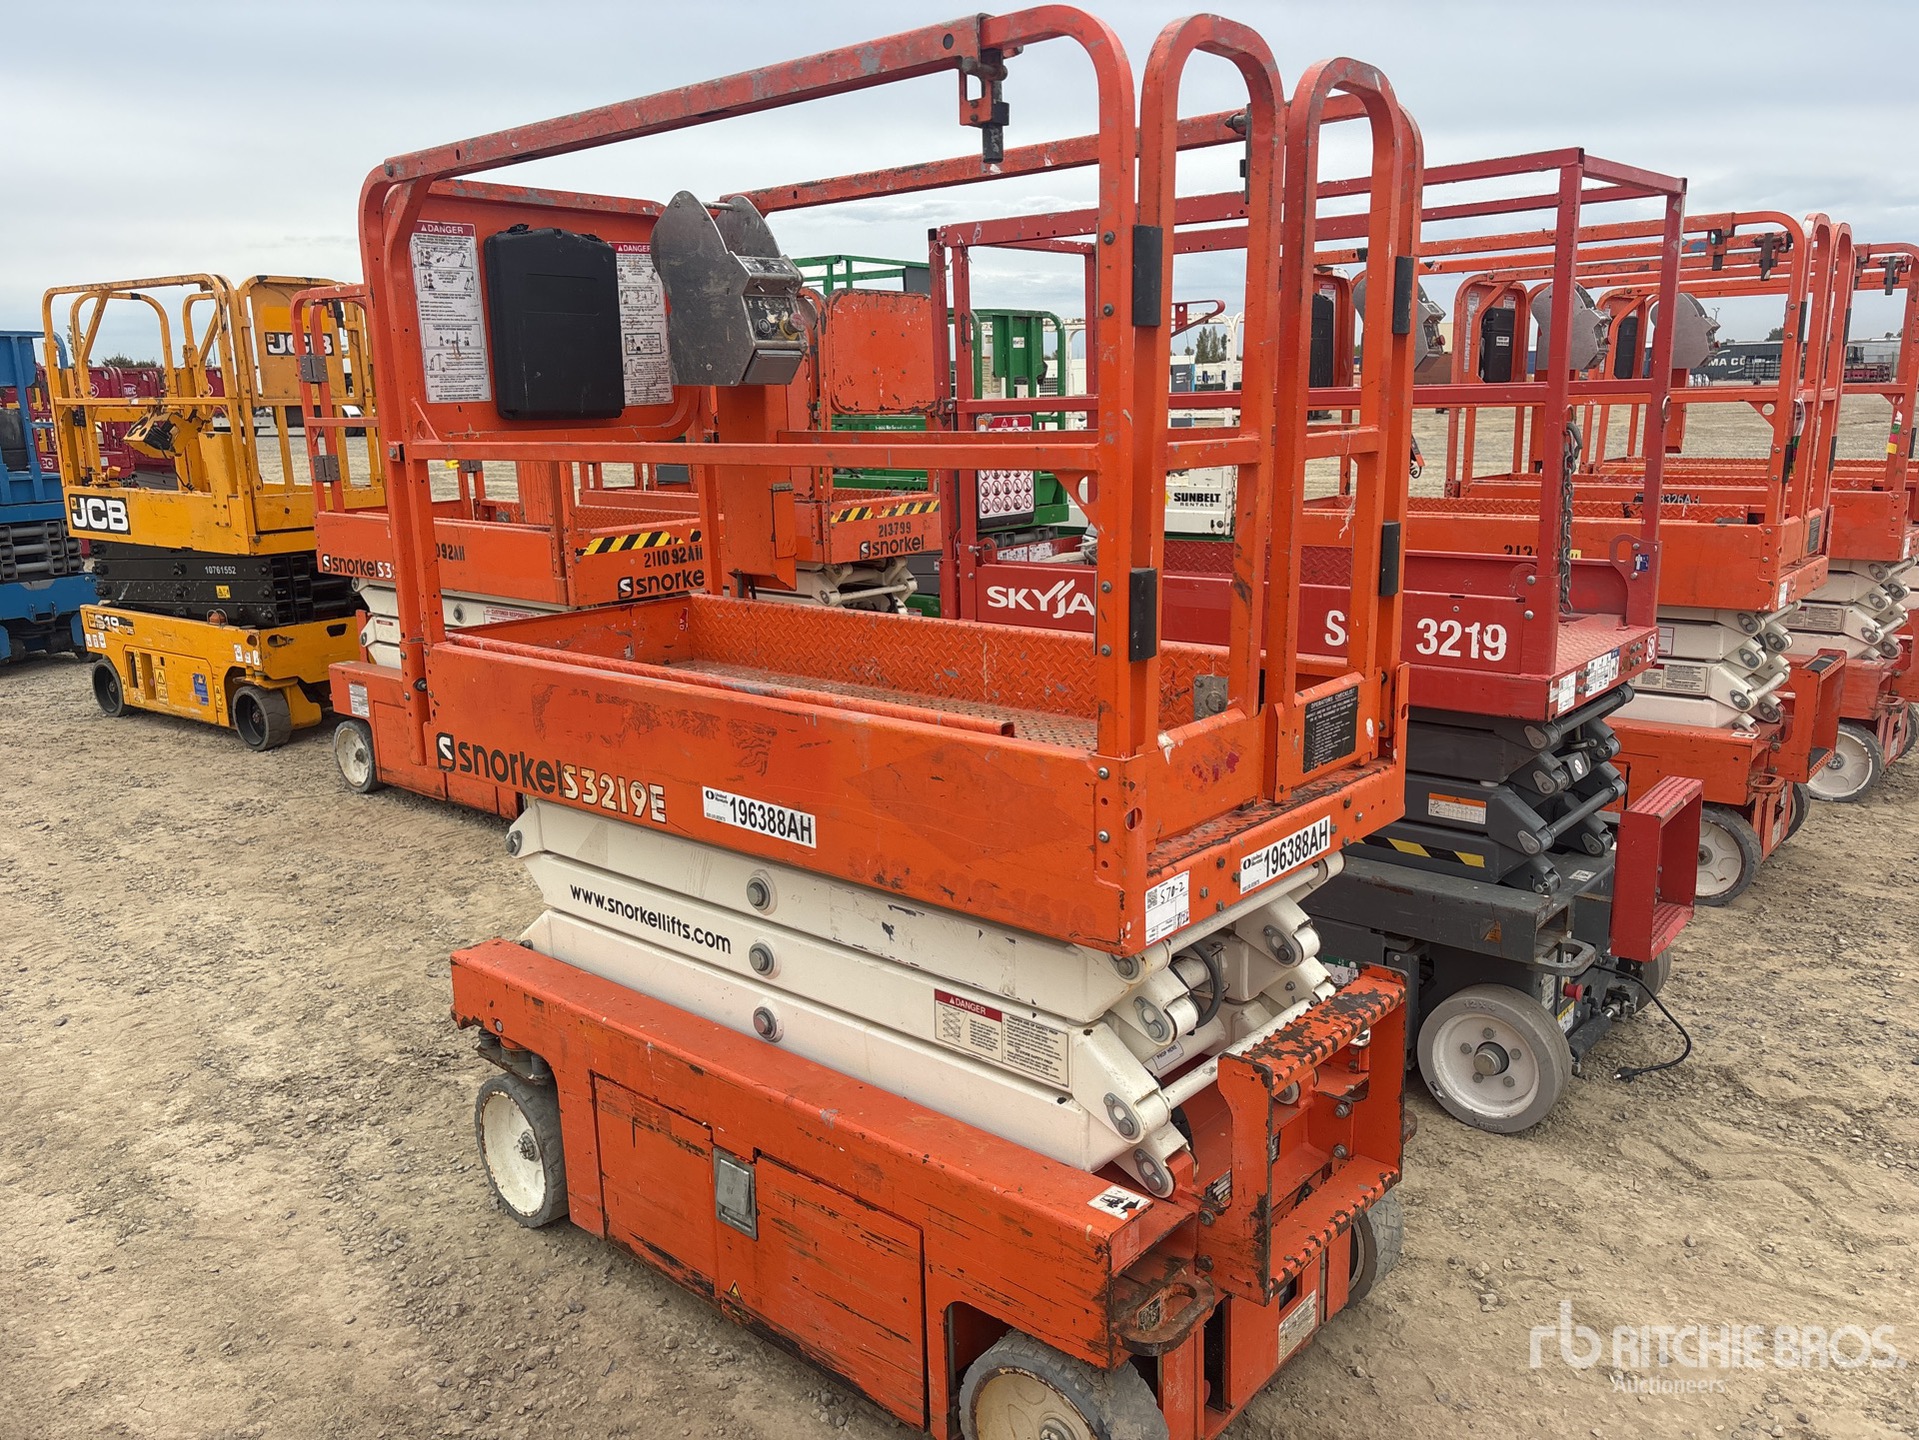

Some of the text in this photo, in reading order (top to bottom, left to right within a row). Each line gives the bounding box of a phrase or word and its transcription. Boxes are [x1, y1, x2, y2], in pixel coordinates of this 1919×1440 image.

[427, 224, 464, 234] DANGER
[1174, 492, 1221, 503] SUNBELT
[71, 497, 129, 532] JCB
[878, 521, 911, 538] 213799
[872, 534, 925, 557] snorkel
[204, 565, 237, 575] 10761552
[332, 556, 378, 578] snorkel
[635, 568, 705, 596] snorke
[986, 578, 1095, 619] SKYJA
[1415, 617, 1508, 662] 3219
[457, 740, 667, 824] snorkel S3219E
[730, 796, 813, 845] 196388AH
[1264, 819, 1328, 878] 196388AH
[569, 884, 731, 954] www.snorkellifts.com
[955, 999, 987, 1016] DANGER
